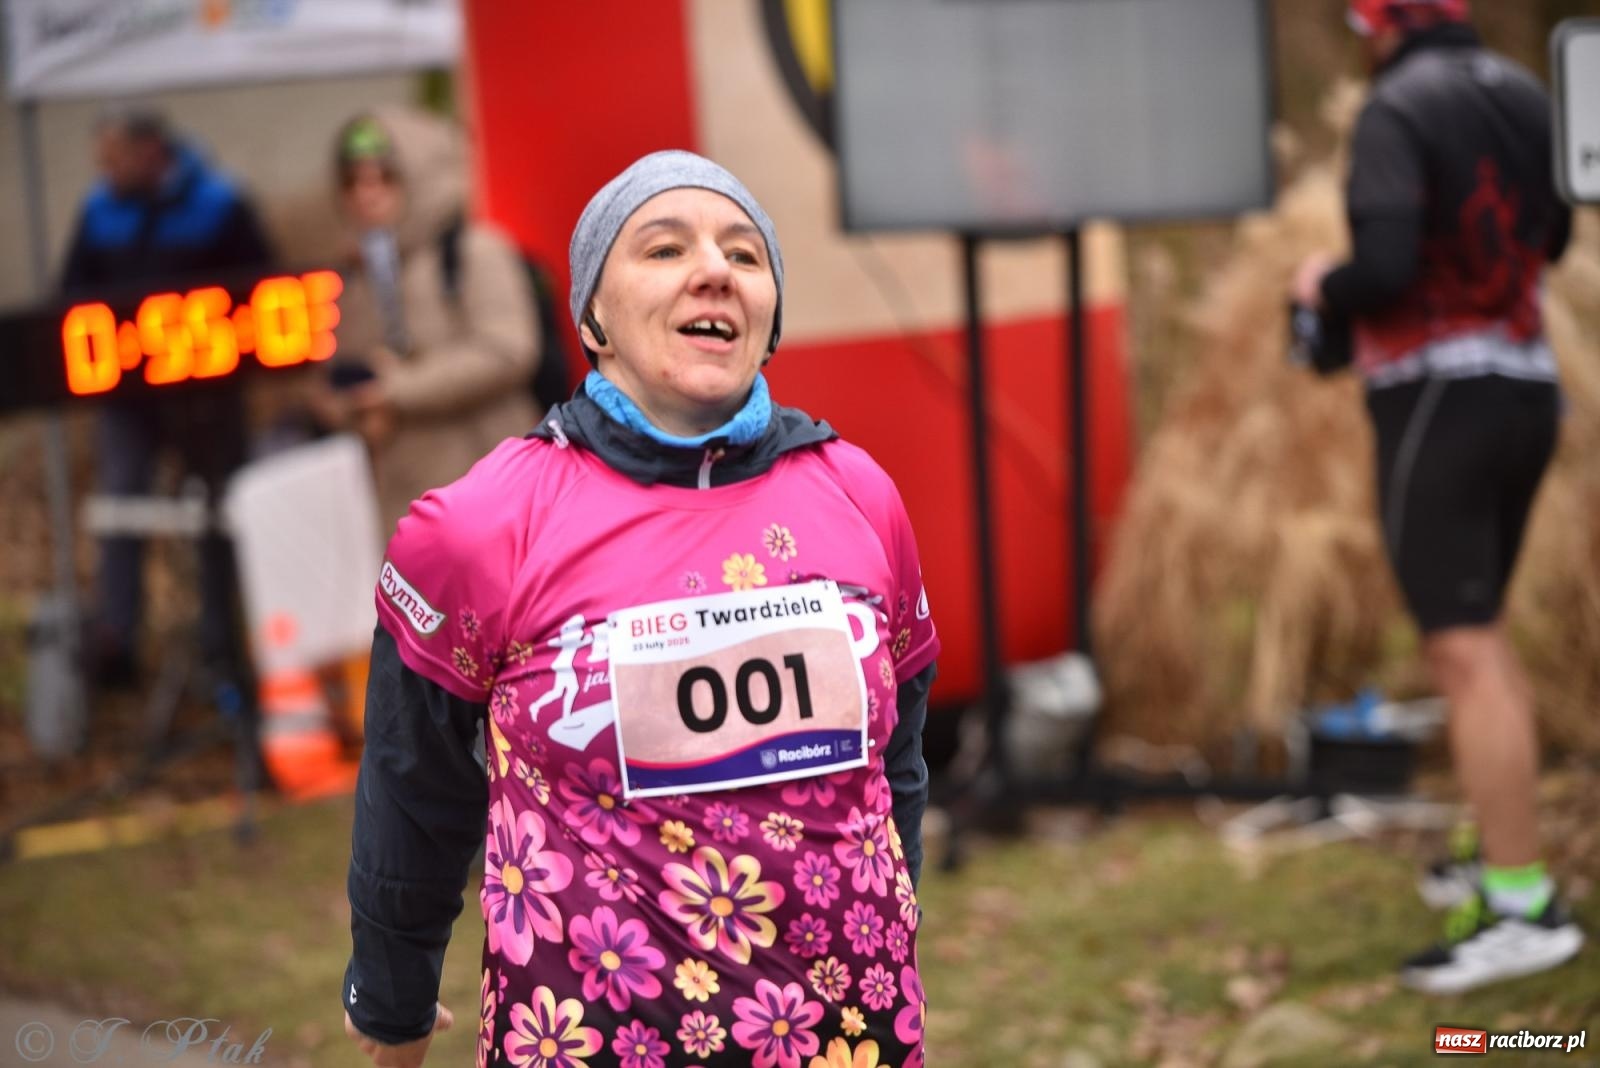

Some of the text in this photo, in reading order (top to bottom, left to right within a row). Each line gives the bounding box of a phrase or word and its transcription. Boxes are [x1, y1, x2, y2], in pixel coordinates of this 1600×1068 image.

[382, 566, 434, 630] Prymat
[631, 597, 823, 637] BIEG Twardziela
[676, 653, 814, 734] 001
[778, 744, 832, 763] Racibórz
